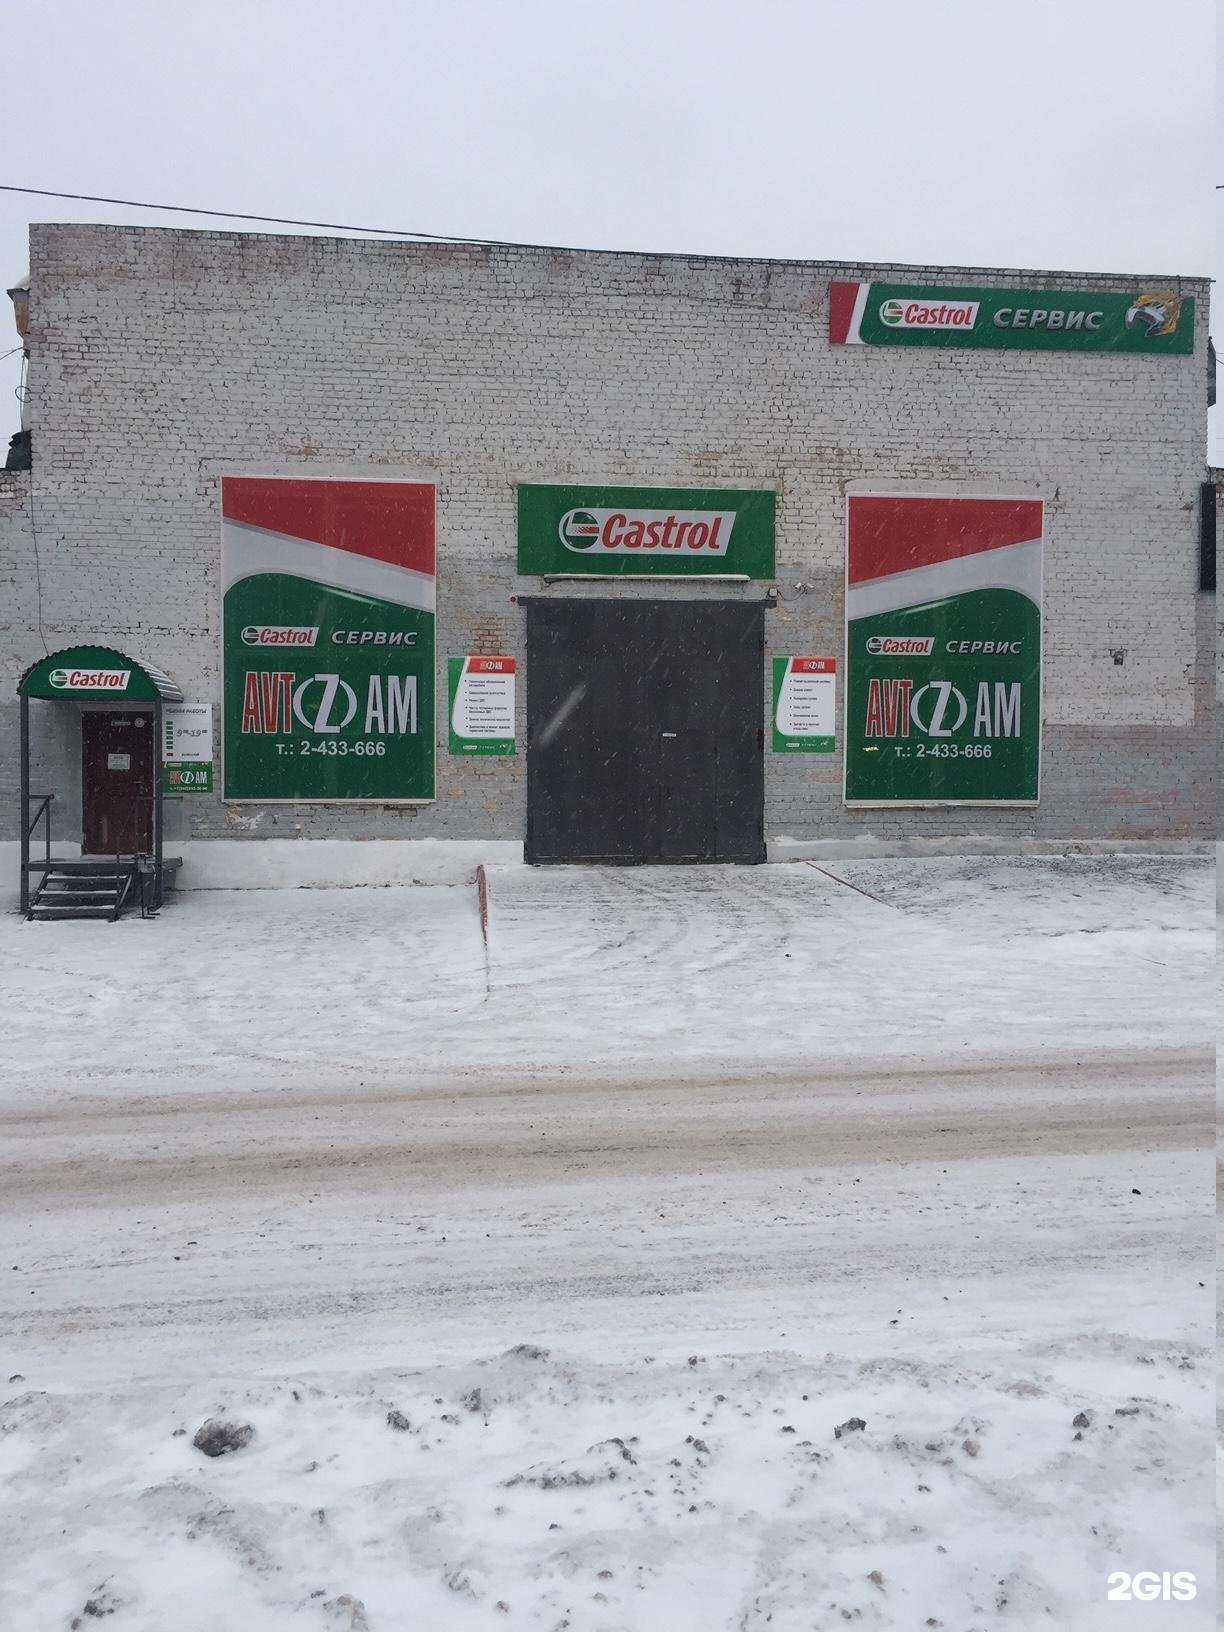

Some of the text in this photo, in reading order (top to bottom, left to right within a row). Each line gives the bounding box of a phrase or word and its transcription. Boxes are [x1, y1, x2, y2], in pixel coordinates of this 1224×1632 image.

[904, 303, 1103, 331] Castrol СЕРВИС
[601, 513, 723, 550] Castrol
[259, 628, 418, 646] Castrol СЕРВИС
[882, 638, 1022, 655] Castrol СЕРВИС
[69, 670, 125, 688] Castrol
[300, 740, 386, 756] 2-433-666
[916, 743, 992, 759] 2-433-666
